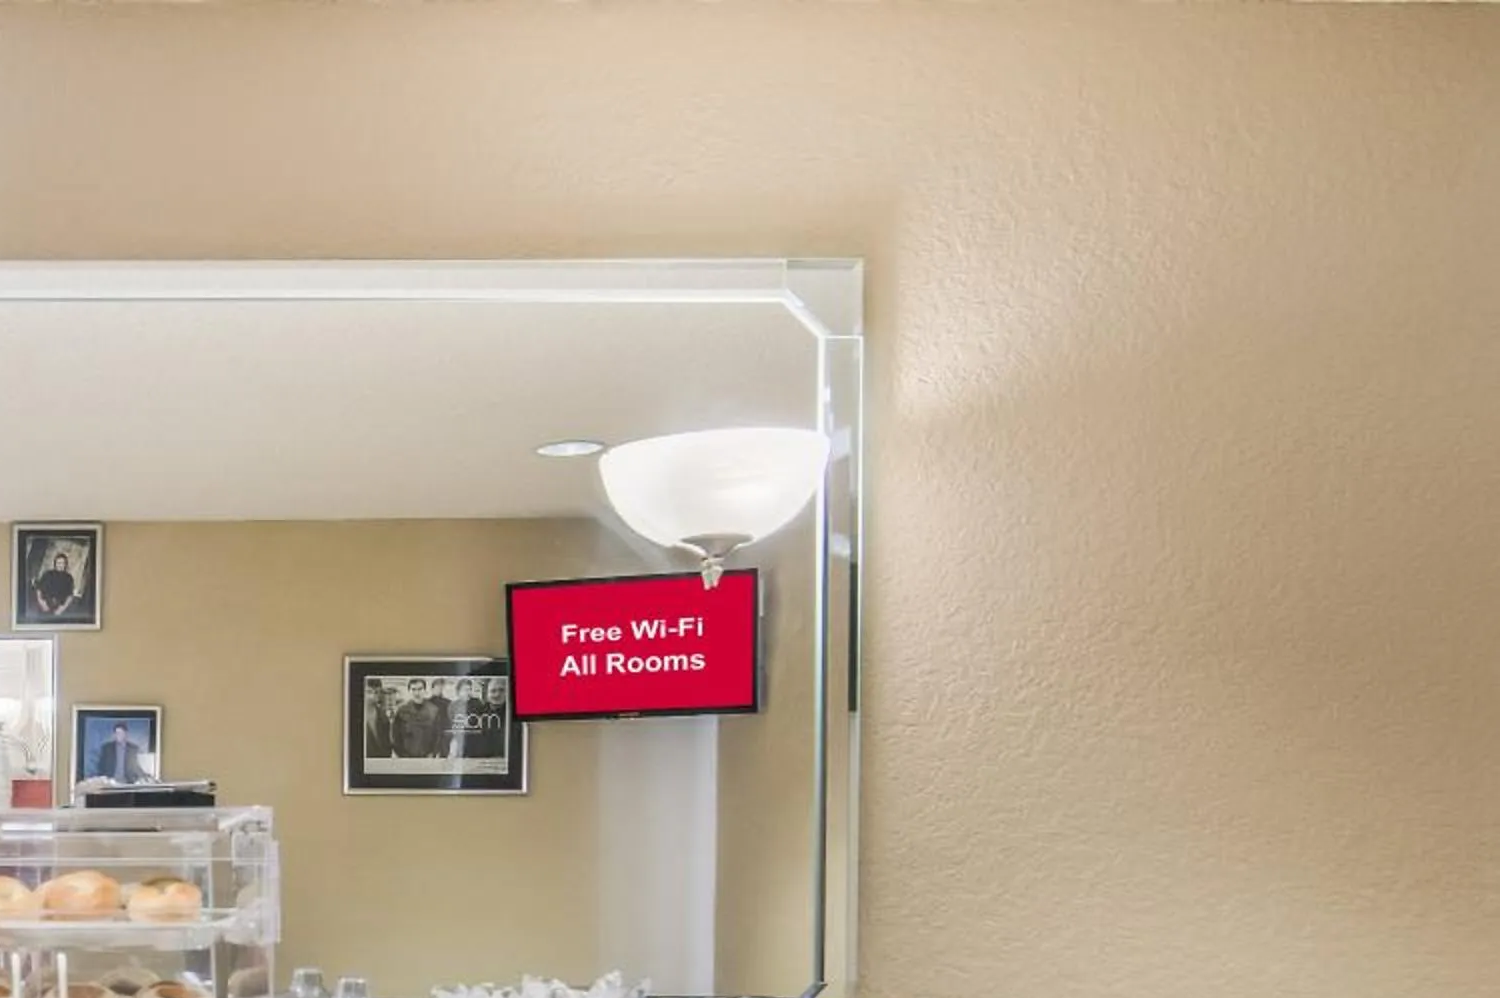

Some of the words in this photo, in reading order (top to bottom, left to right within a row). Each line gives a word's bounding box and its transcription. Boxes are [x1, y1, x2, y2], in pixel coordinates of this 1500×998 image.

[561, 623, 623, 644] Free
[630, 617, 704, 640] Wi-Fi
[559, 653, 597, 677] All
[606, 652, 706, 675] Rooms
